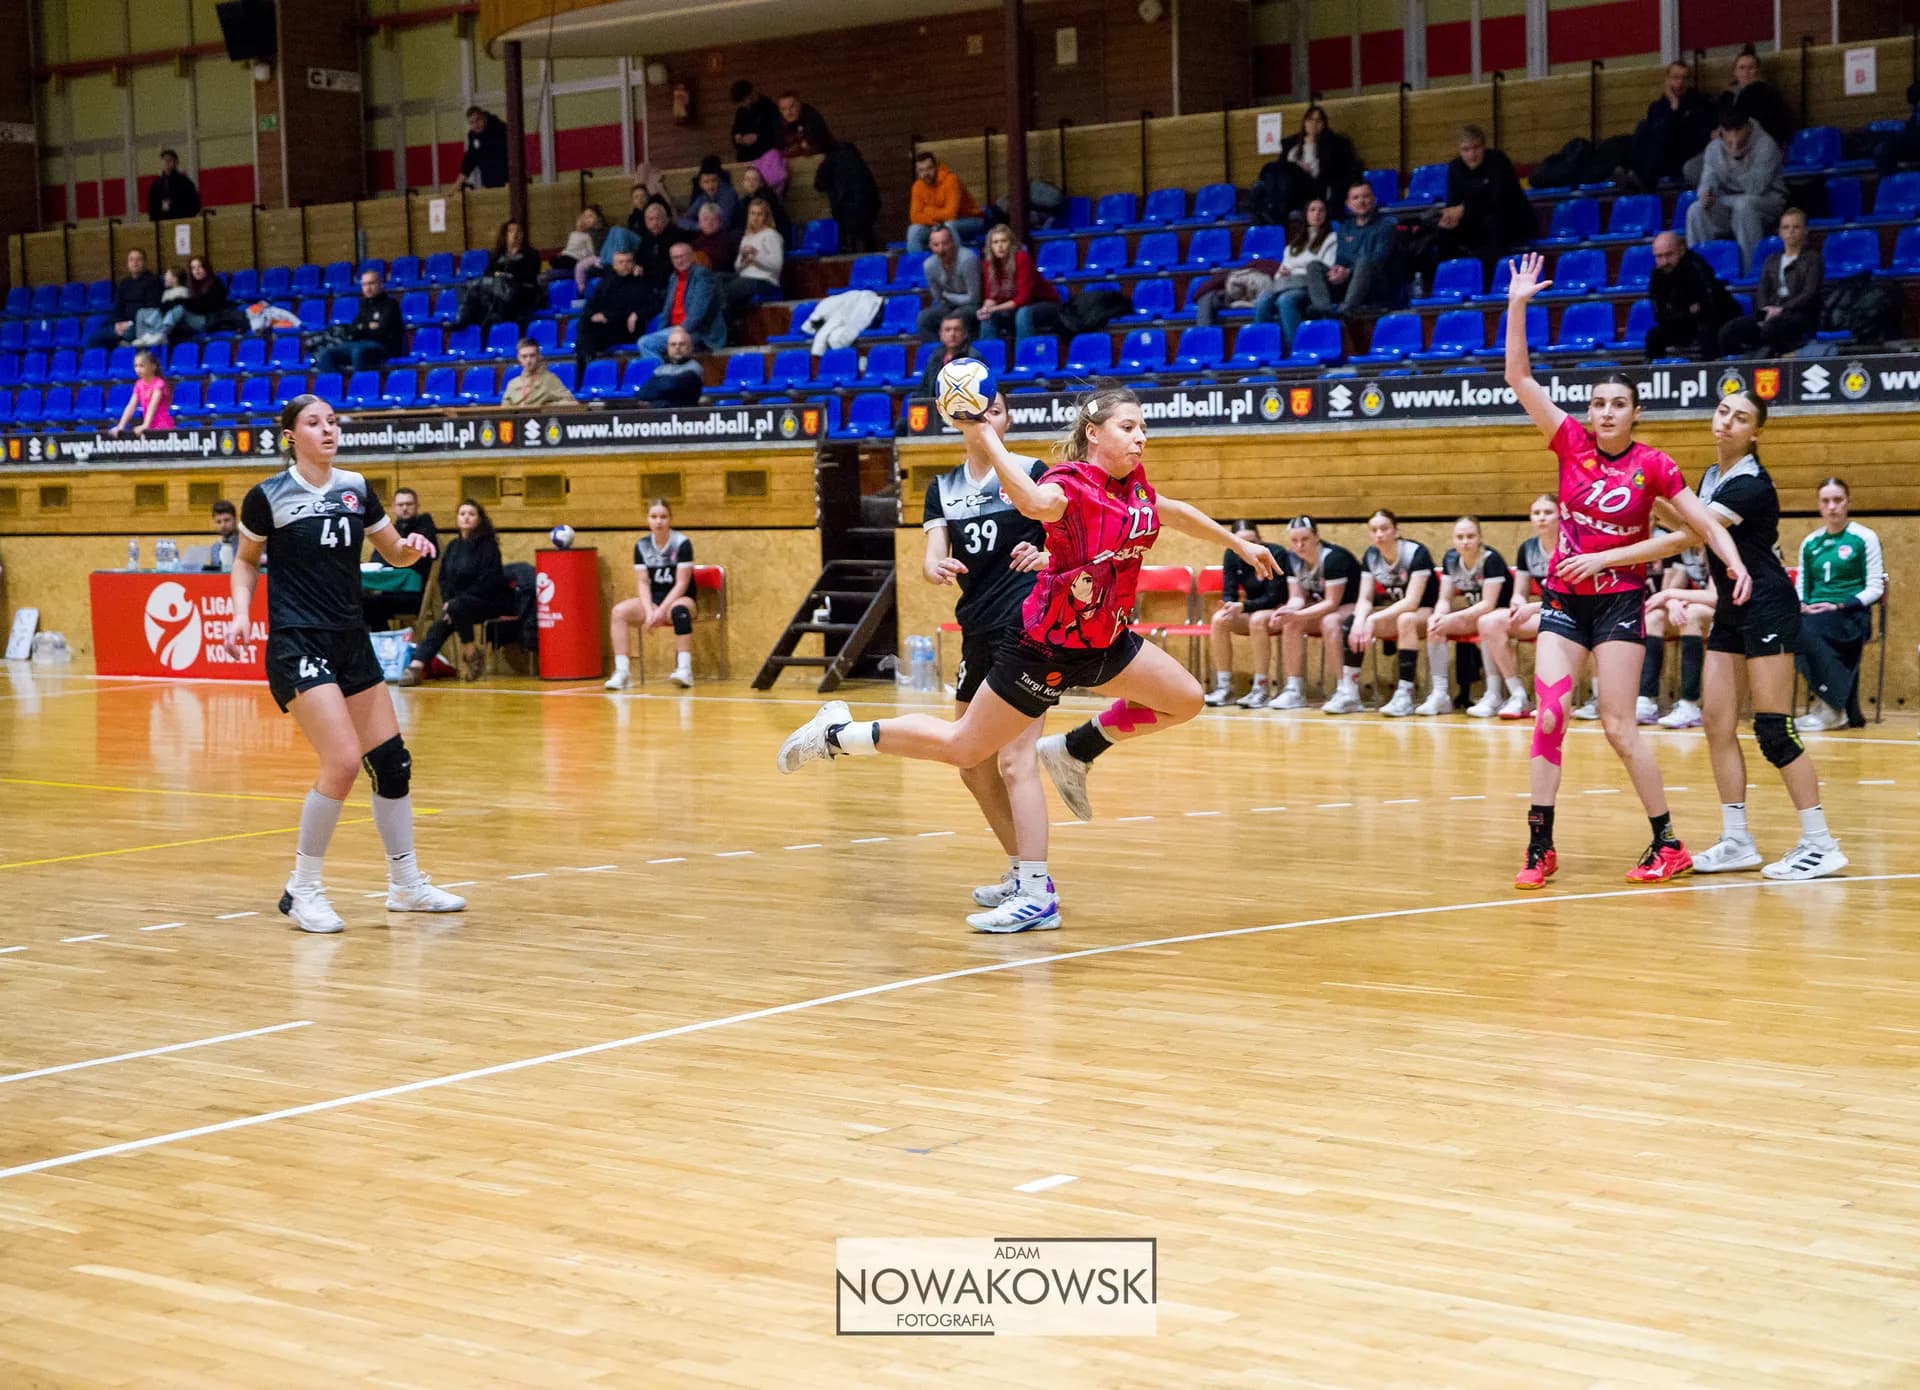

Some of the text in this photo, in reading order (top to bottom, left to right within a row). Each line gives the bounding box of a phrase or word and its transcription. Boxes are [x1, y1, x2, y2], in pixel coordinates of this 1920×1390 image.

[1265, 131, 1274, 143] A
[566, 411, 774, 440] www.koronahandball.pl
[60, 431, 217, 457] www.koronahandball.pl
[1584, 479, 1632, 513] 10
[320, 516, 351, 548] 41
[1127, 506, 1157, 539] 22
[964, 519, 998, 554] 39
[654, 568, 674, 584] 44
[1823, 561, 1831, 583] 1
[201, 596, 233, 616] LIGA
[205, 644, 257, 664] KOIET
[1020, 671, 1044, 692] Targi
